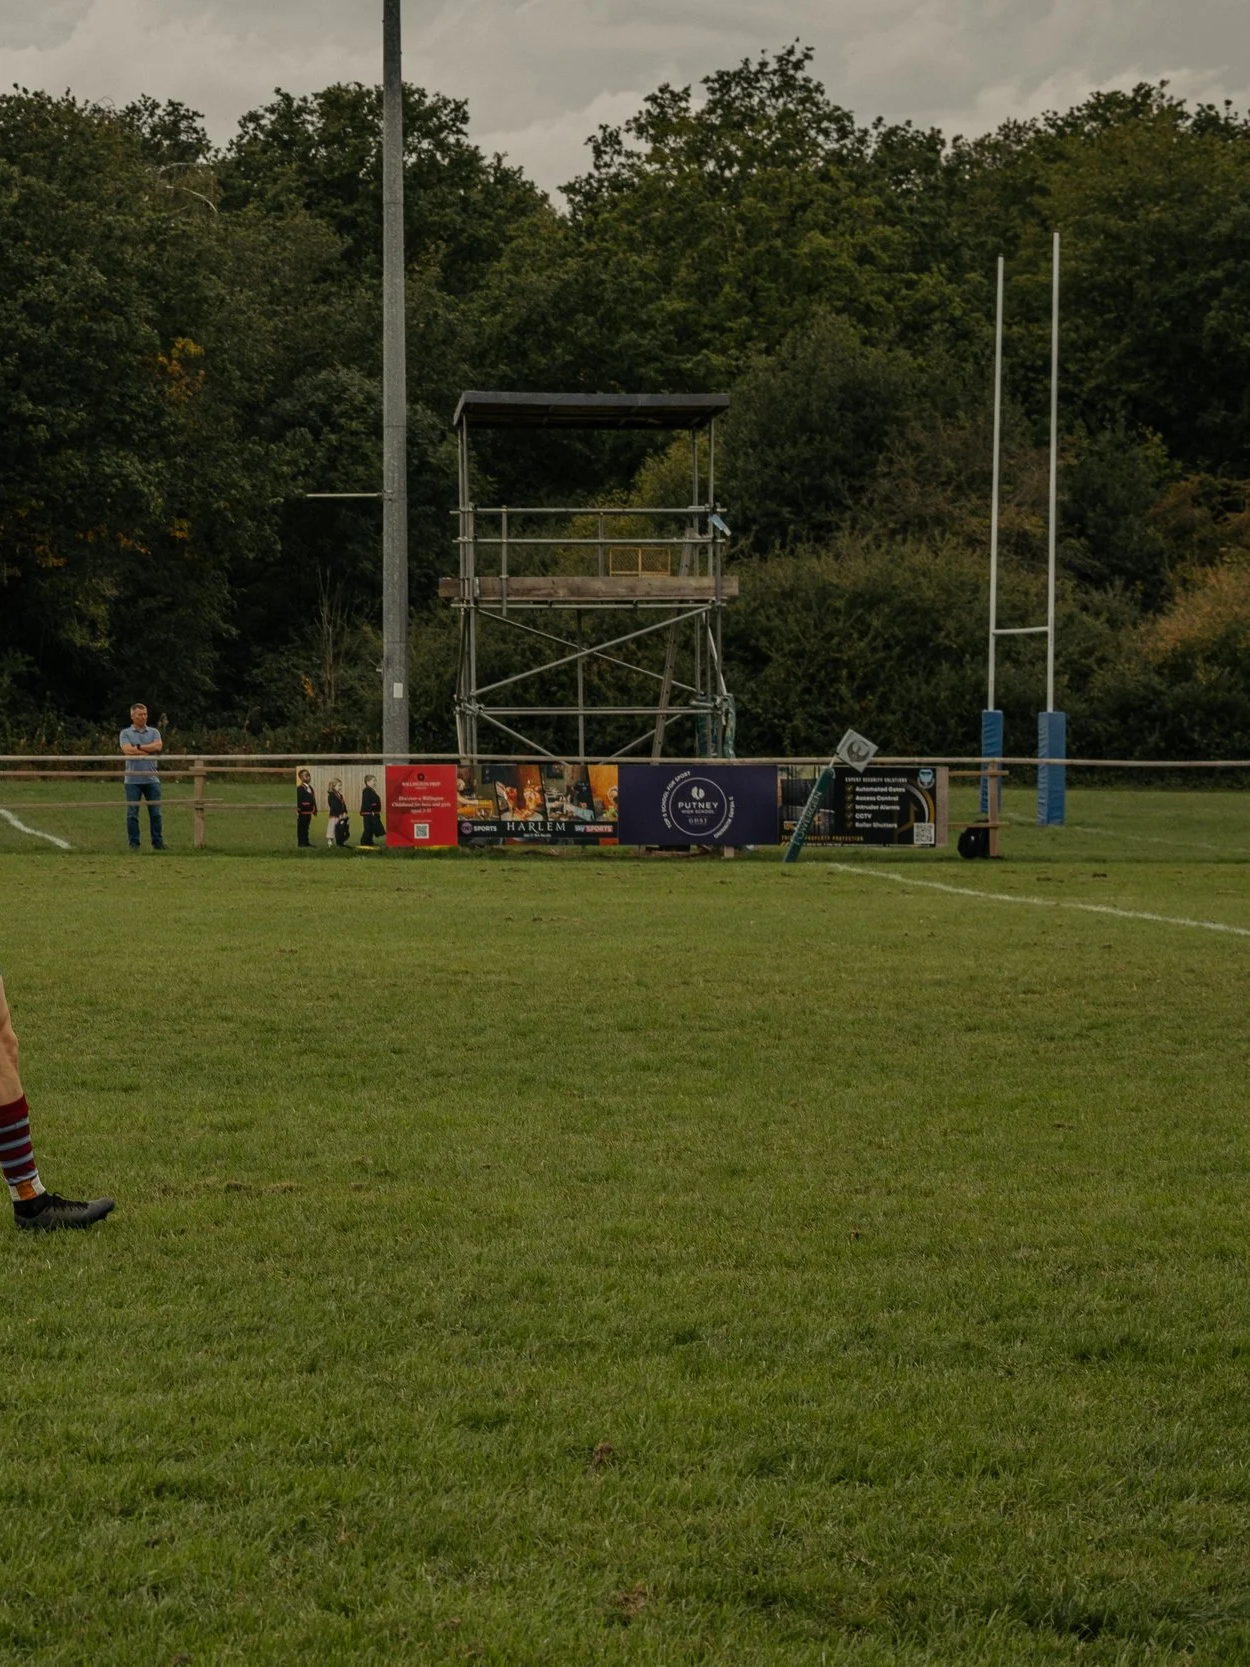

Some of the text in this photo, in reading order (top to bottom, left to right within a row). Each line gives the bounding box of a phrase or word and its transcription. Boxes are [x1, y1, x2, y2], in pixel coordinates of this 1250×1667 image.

[661, 791, 670, 812] SCHOOL
[667, 780, 676, 791] FOR
[674, 770, 691, 782] SPORT
[506, 821, 566, 833] HARLEM
[794, 791, 822, 846] POWERGEN
